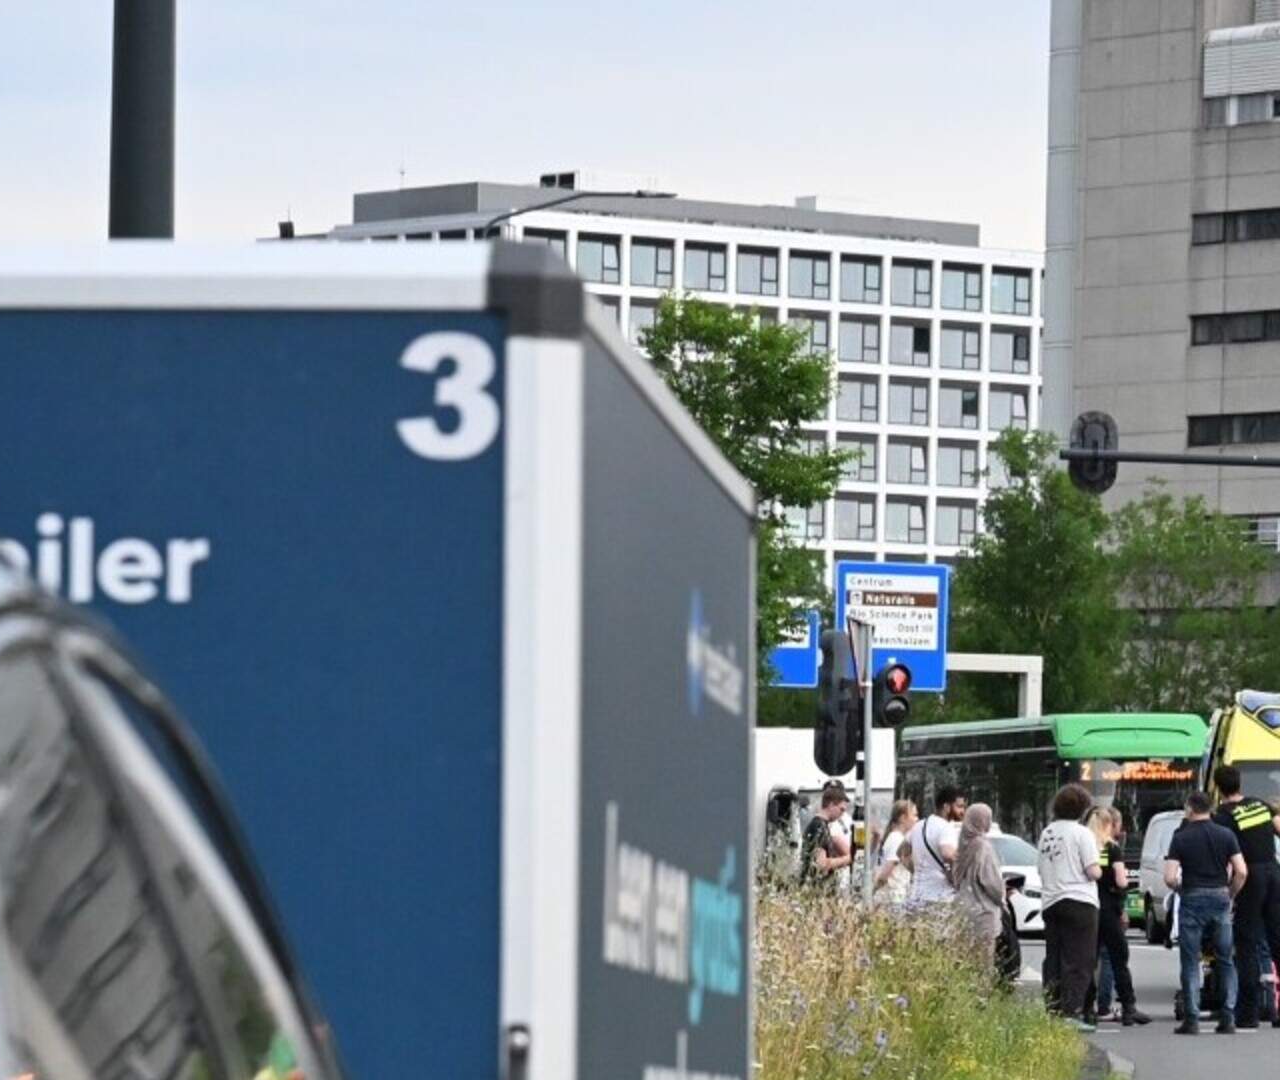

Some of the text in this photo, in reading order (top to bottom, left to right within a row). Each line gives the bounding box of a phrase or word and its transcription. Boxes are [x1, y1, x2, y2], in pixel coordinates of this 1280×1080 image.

[396, 330, 499, 461] 3
[849, 576, 893, 586] Centrum
[864, 593, 916, 606] Naturalis
[869, 609, 908, 620] Science
[911, 611, 933, 621] Park
[1080, 761, 1091, 781] 2
